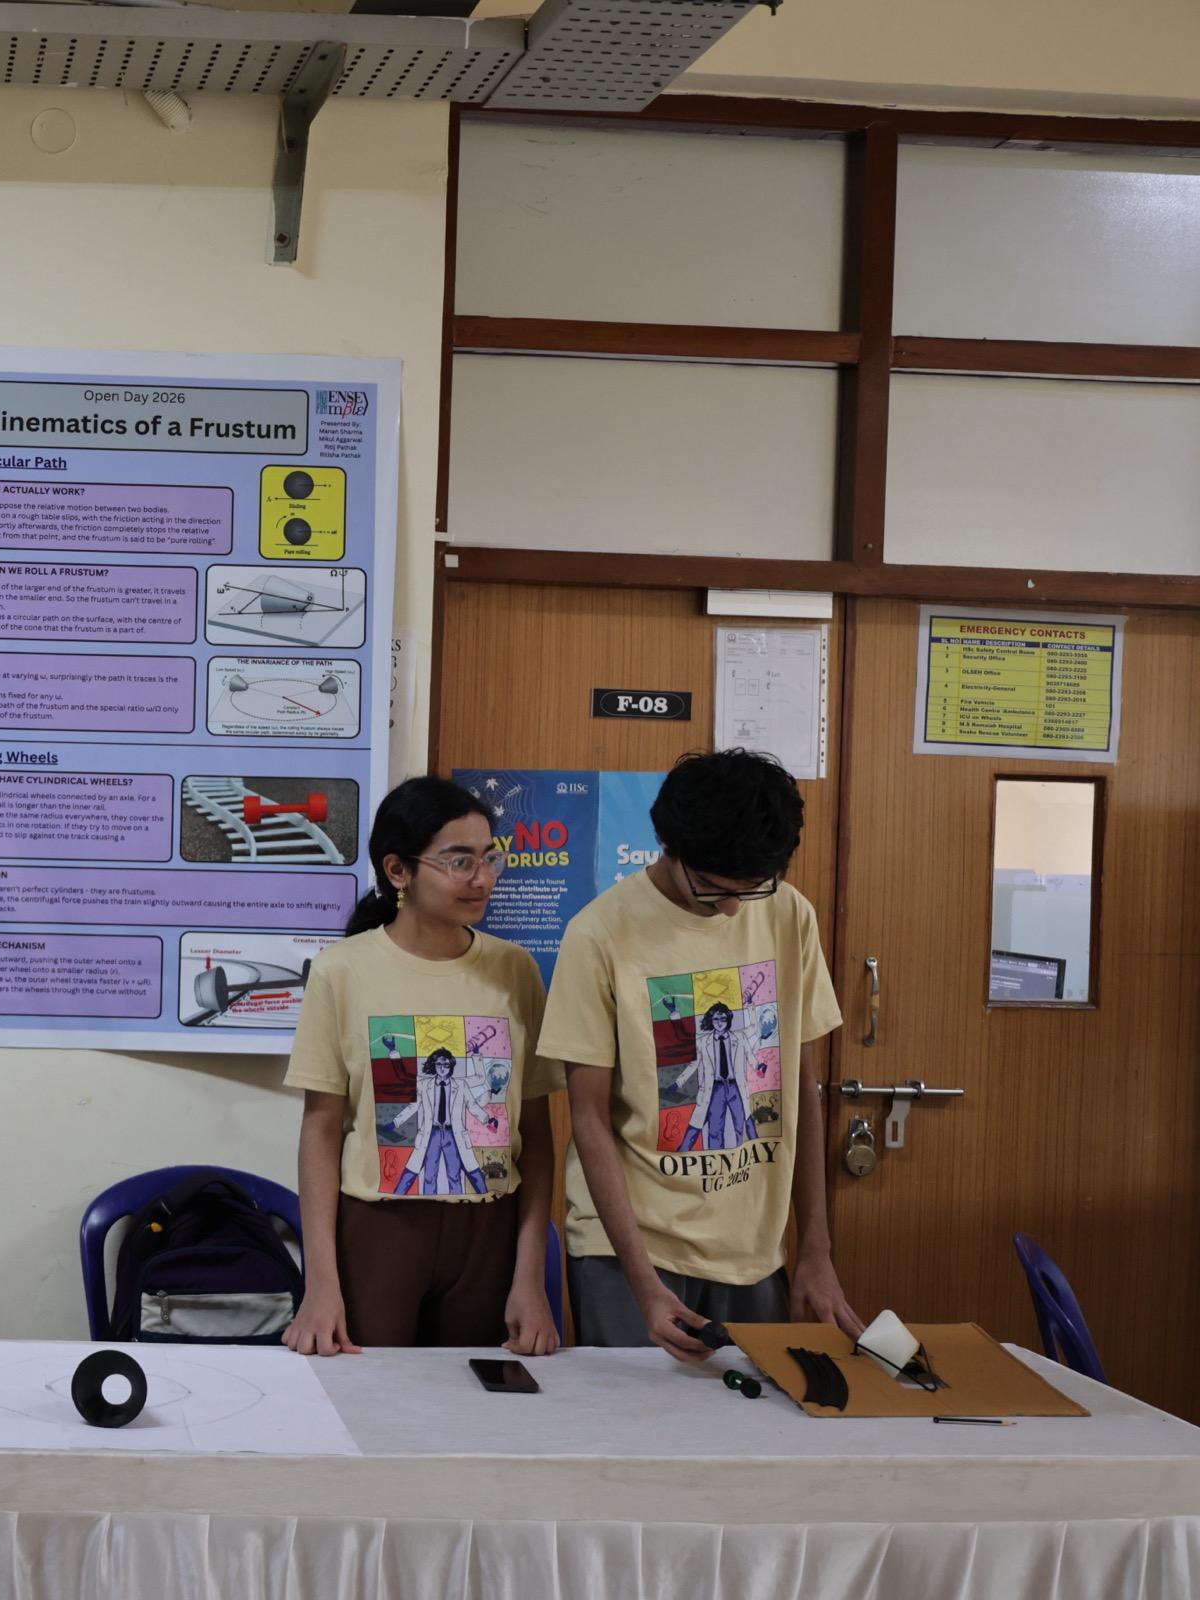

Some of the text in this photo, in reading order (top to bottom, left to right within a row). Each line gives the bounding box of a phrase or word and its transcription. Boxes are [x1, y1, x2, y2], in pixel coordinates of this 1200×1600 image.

[84, 390, 186, 405] Open Day 2026
[135, 415, 162, 435] of
[168, 421, 182, 436] a
[190, 418, 296, 439] Frustum
[34, 456, 67, 469] Path
[3, 486, 50, 494] ACTUALLY
[24, 567, 49, 575] ROLL
[59, 568, 109, 576] FRUSTUM?
[960, 625, 1086, 639] EMERGENCY CONTACTS
[617, 696, 668, 713] F-08
[6, 751, 58, 764] Wheels
[26, 776, 88, 785] CYLINDRICAL
[90, 778, 133, 786] WHEELS?
[569, 782, 589, 792] IISc
[492, 820, 569, 852] AY NO
[508, 851, 570, 868] DRUGS
[660, 1142, 781, 1176] OPEN DAY
[702, 1168, 750, 1193] UG 2026
